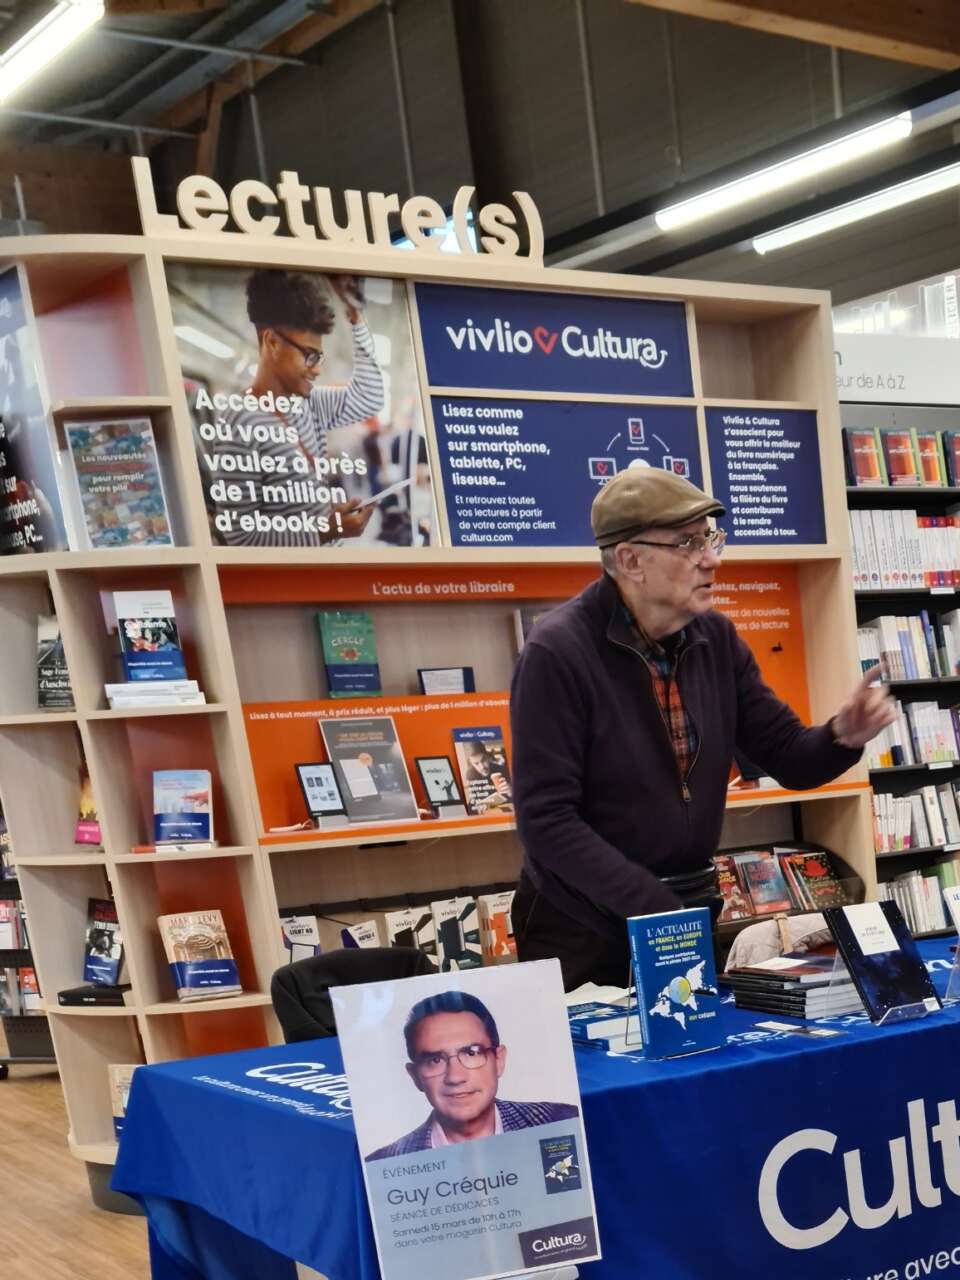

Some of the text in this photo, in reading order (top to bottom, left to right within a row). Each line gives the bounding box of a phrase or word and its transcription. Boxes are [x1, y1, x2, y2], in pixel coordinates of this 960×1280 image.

[131, 156, 544, 268] Lecture(s)
[446, 318, 668, 368] vivlio Cultura
[856, 372, 905, 390] de A à Z
[195, 388, 303, 413] Accédez
[442, 404, 523, 419] Lisez comme
[752, 417, 780, 425] Cultura
[200, 418, 299, 443] où vous
[445, 423, 519, 436] vous voulez
[767, 429, 784, 438] pour
[448, 440, 550, 455] sur smartphone,
[726, 450, 795, 460] du livre numérique
[203, 450, 367, 480] voulez à près
[450, 456, 526, 471] tablette, PC,
[92, 474, 112, 485] pour
[210, 480, 347, 503] de 1 million
[761, 495, 771, 503] du
[772, 495, 788, 503] livre
[455, 495, 535, 504] Et retrouvez toutes
[215, 510, 343, 532] d'ebooks !
[457, 508, 543, 519] vos lectures à partir
[748, 517, 771, 525] rendre
[459, 520, 556, 531] de votre compte client
[734, 528, 772, 536] accessible
[461, 533, 513, 542] cultura.com
[372, 580, 515, 595] L'actu de votre libraire
[741, 608, 751, 617] de
[197, 914, 218, 924] LEVY
[387, 1169, 519, 1206] Guy Créquie
[390, 1197, 500, 1223] SÉANCE DE DÉDICACES
[392, 1208, 522, 1238] Samedi 15 mars de 10h à 17h
[394, 1237, 420, 1249] dans
[421, 1232, 446, 1244] votre
[446, 1226, 488, 1240] magasin
[532, 1231, 587, 1252] Cultura
